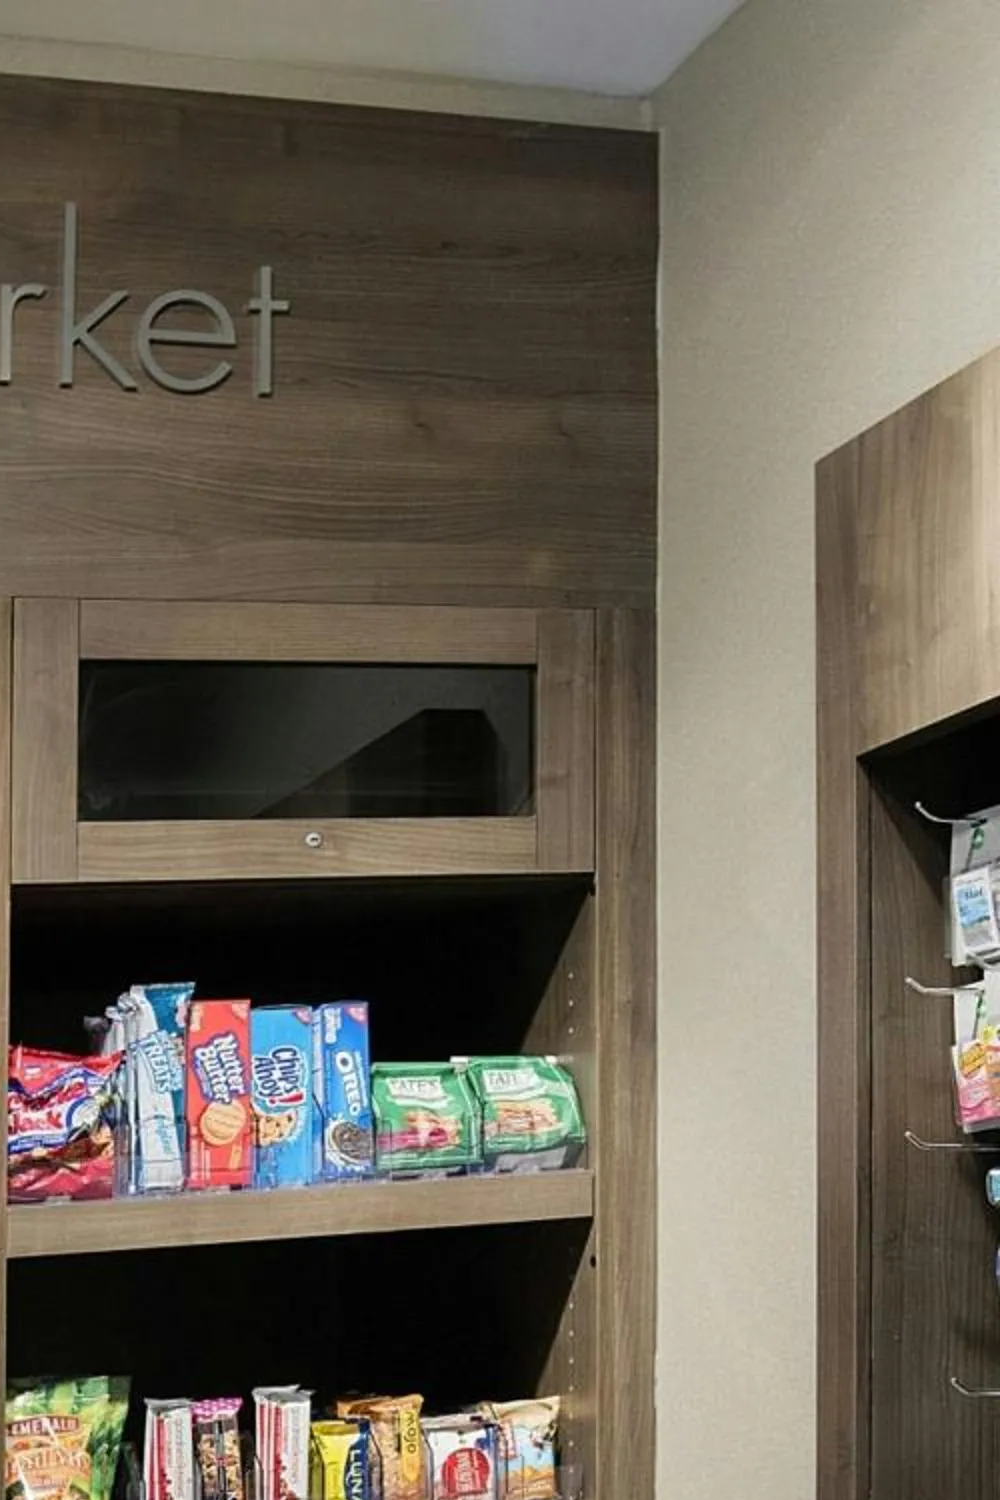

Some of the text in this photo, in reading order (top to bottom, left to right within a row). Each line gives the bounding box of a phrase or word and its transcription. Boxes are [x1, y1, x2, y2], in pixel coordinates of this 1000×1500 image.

[198, 1046, 232, 1104] Butter
[214, 1033, 246, 1095] Nutter
[271, 1047, 301, 1093] Chips
[335, 1051, 361, 1116] OREO
